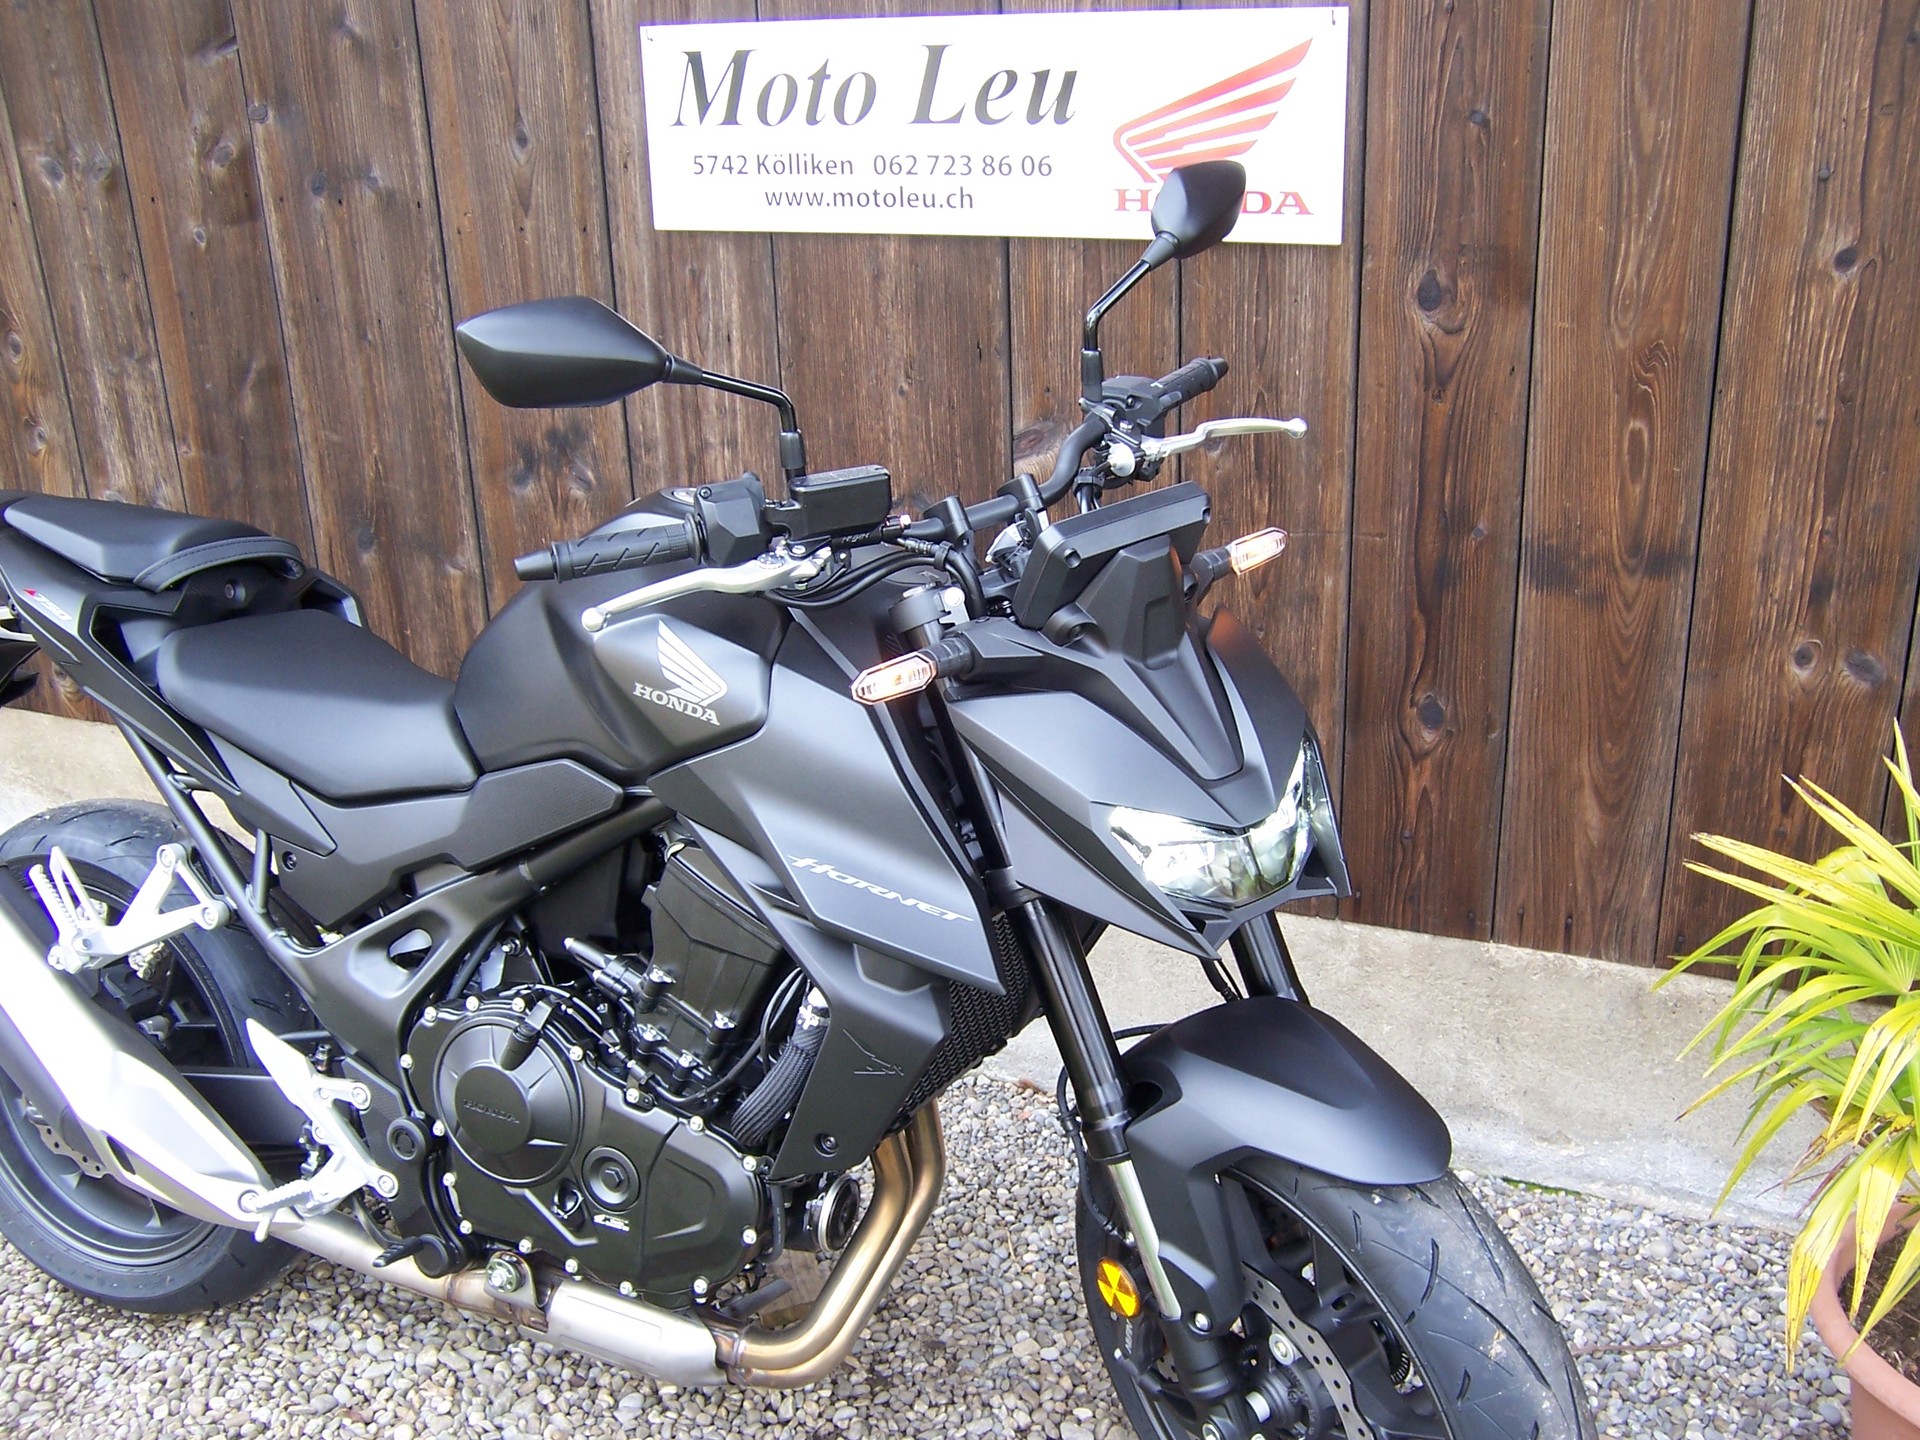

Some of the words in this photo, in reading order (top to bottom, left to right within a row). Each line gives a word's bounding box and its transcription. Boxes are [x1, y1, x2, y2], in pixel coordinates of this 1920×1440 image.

[669, 48, 877, 126] Moto
[907, 44, 1077, 126] Leu
[692, 154, 749, 175] 5742
[756, 152, 854, 175] Kölliken
[873, 154, 919, 176] 062
[926, 154, 973, 176] 723
[981, 154, 1013, 177] 86
[1020, 154, 1053, 177] 06
[764, 185, 974, 209] www.motoleu.ch
[1114, 188, 1315, 216] HDA
[633, 682, 720, 726] HONDA
[463, 1098, 520, 1124] HONDA
